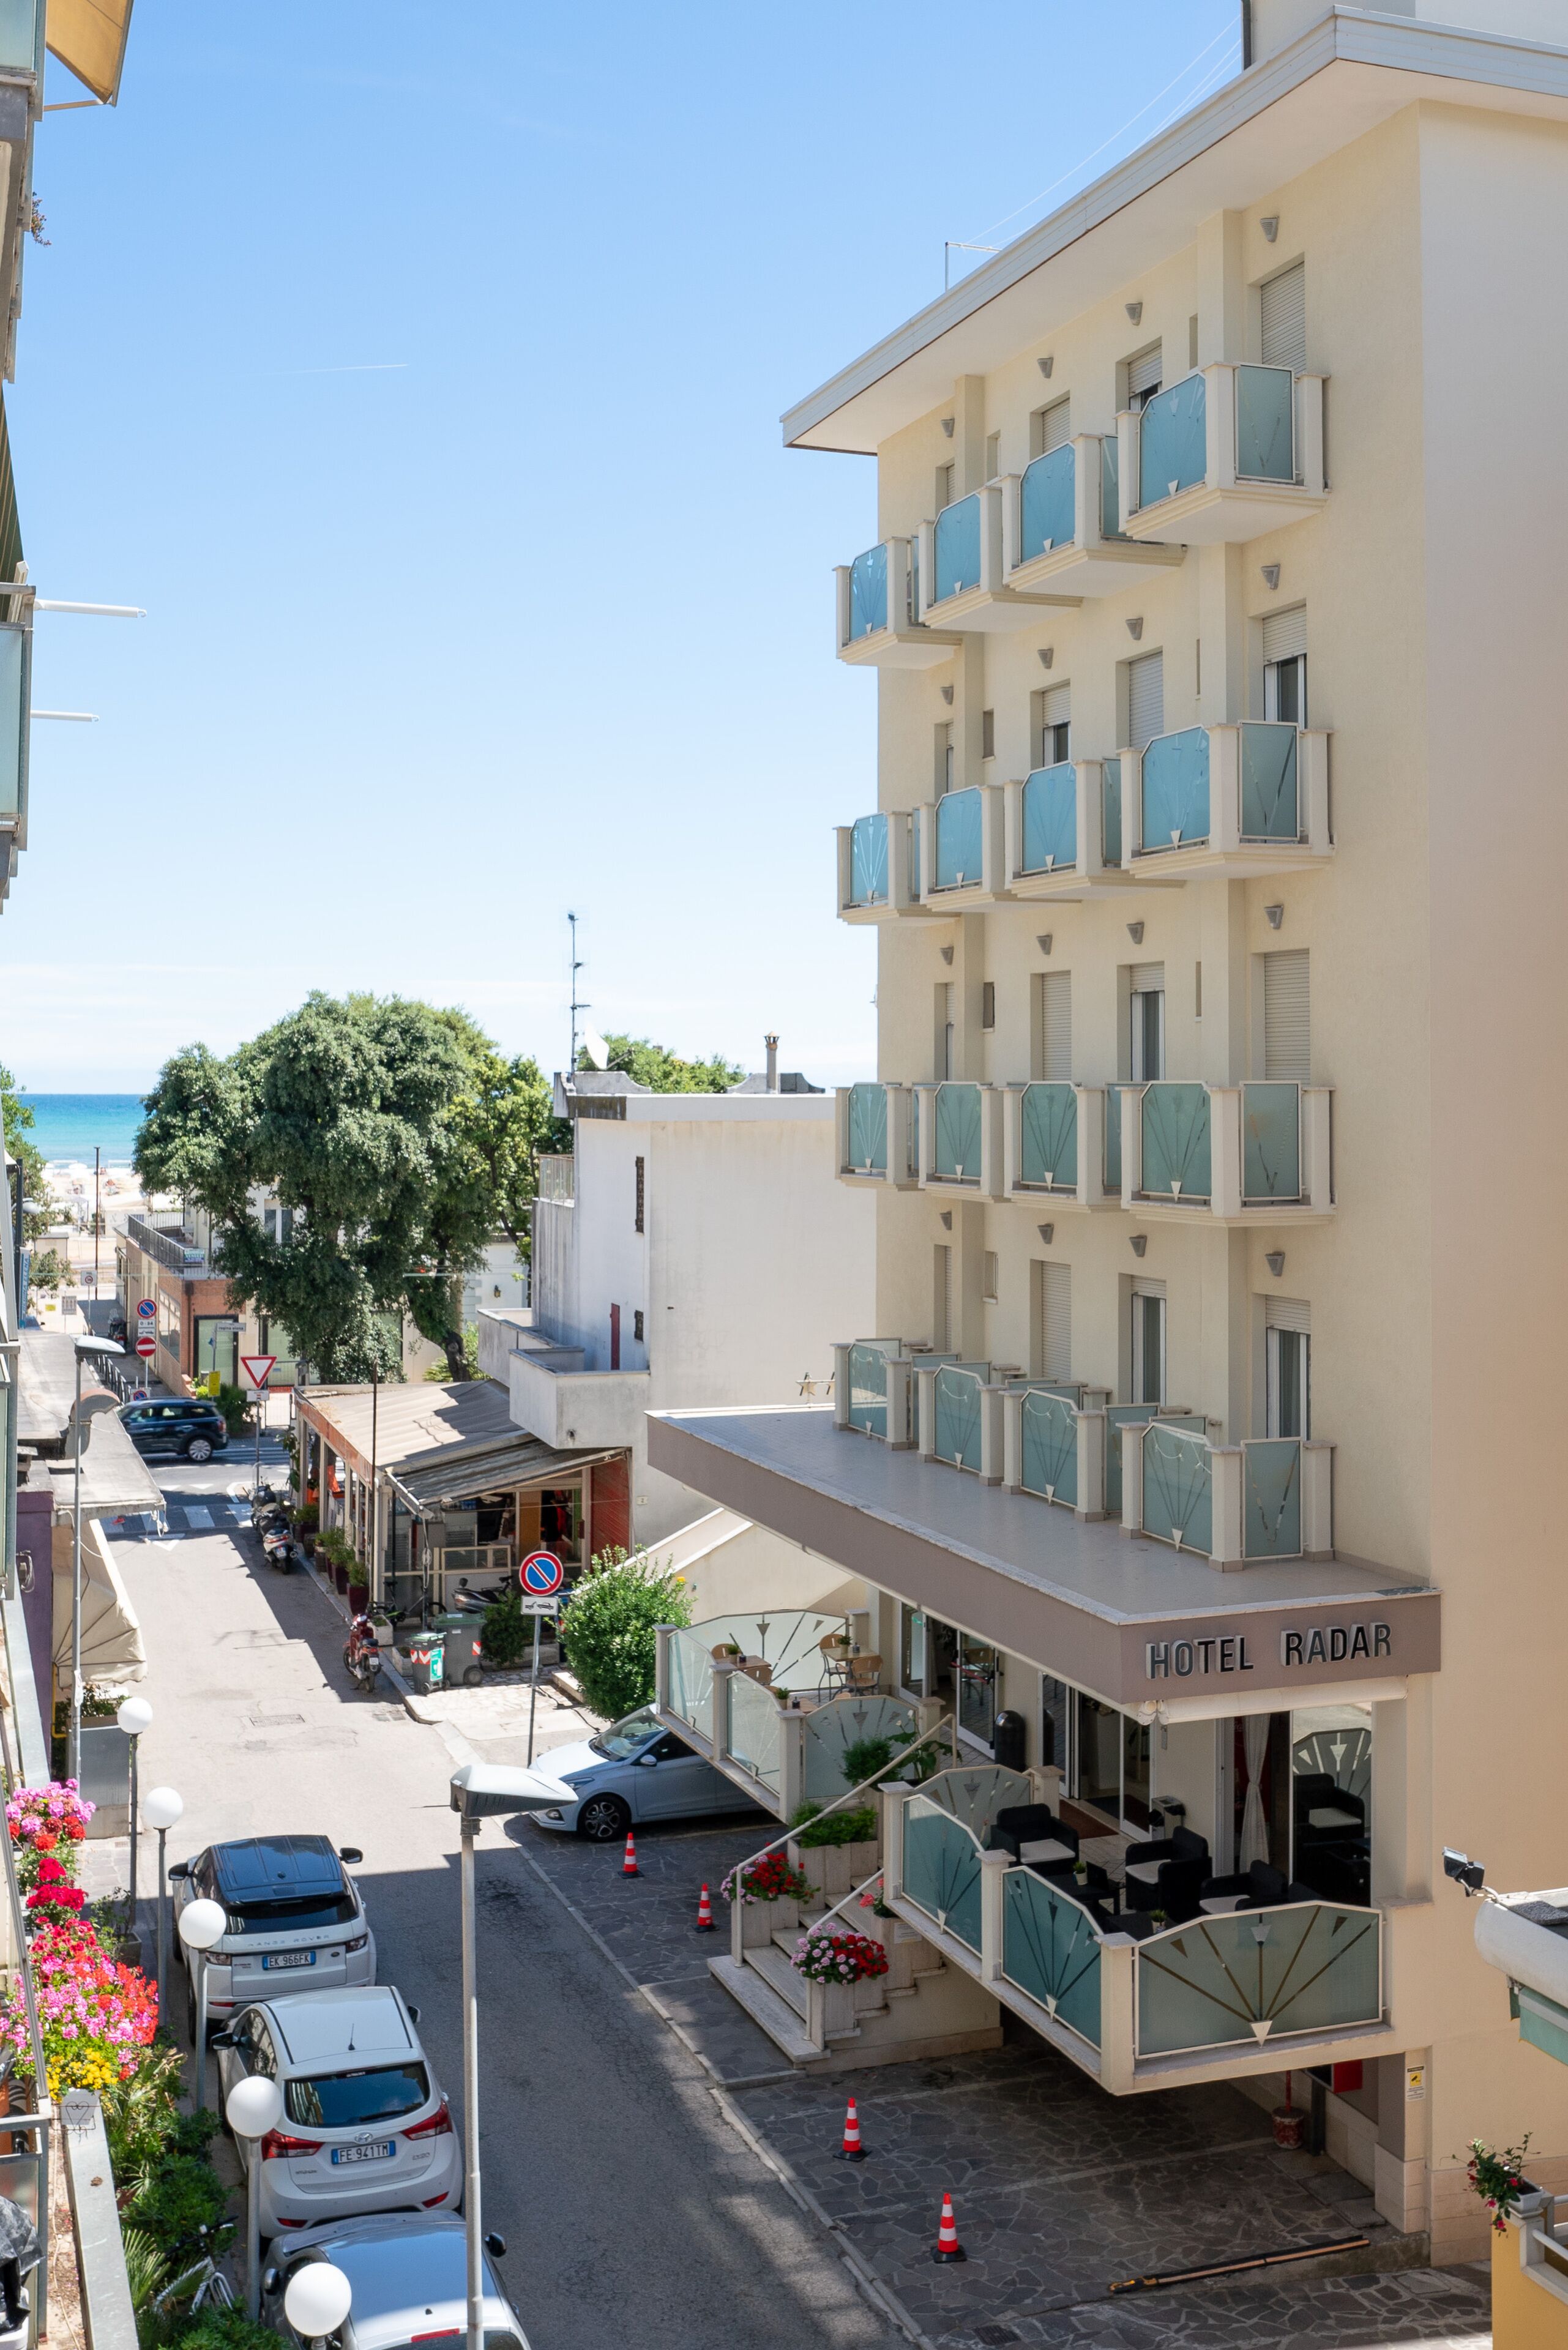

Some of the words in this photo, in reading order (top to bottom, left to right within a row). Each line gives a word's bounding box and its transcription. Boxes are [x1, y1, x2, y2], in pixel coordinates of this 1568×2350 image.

[1146, 1635, 1254, 1679] HOTEL
[1280, 1622, 1392, 1666] RADAR
[339, 2149, 353, 2162] FE
[356, 2144, 389, 2158] 941TM
